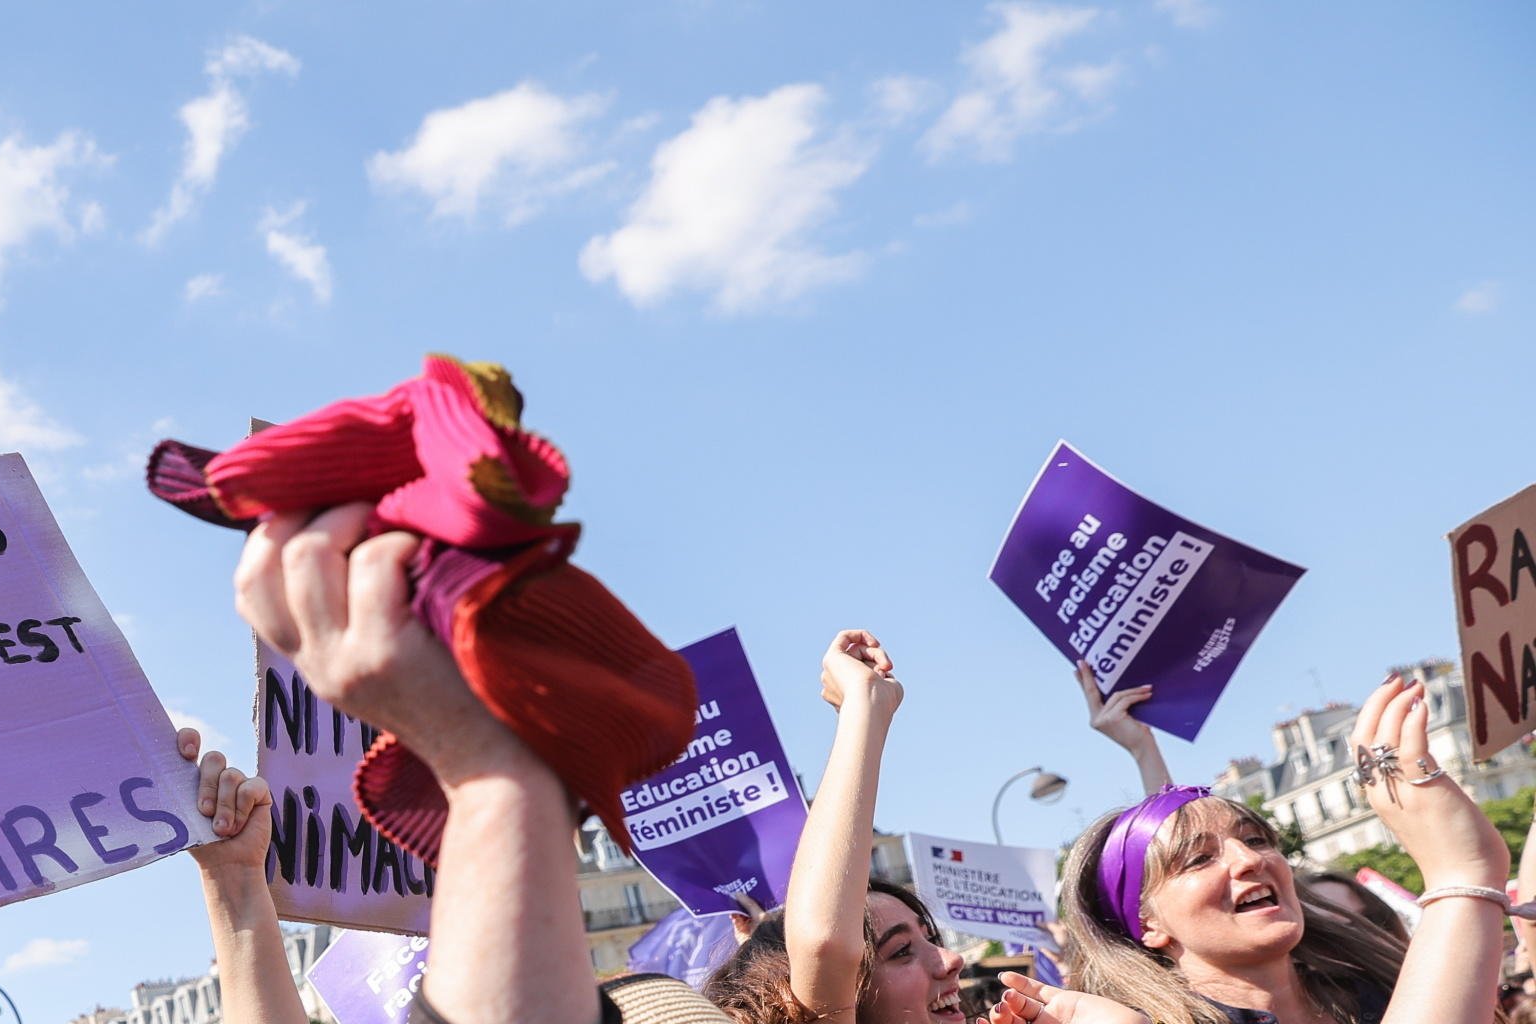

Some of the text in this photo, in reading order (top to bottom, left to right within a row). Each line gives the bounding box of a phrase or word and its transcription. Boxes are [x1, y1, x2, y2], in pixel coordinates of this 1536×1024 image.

[1035, 513, 1102, 602] Face au
[1057, 530, 1128, 624] racisme
[1068, 534, 1168, 654] Education
[1093, 558, 1189, 685] féministe
[265, 667, 318, 755] NI
[619, 750, 762, 813] Education
[629, 784, 762, 843] féministe
[950, 905, 995, 923] C'EST
[995, 911, 1034, 927] NON
